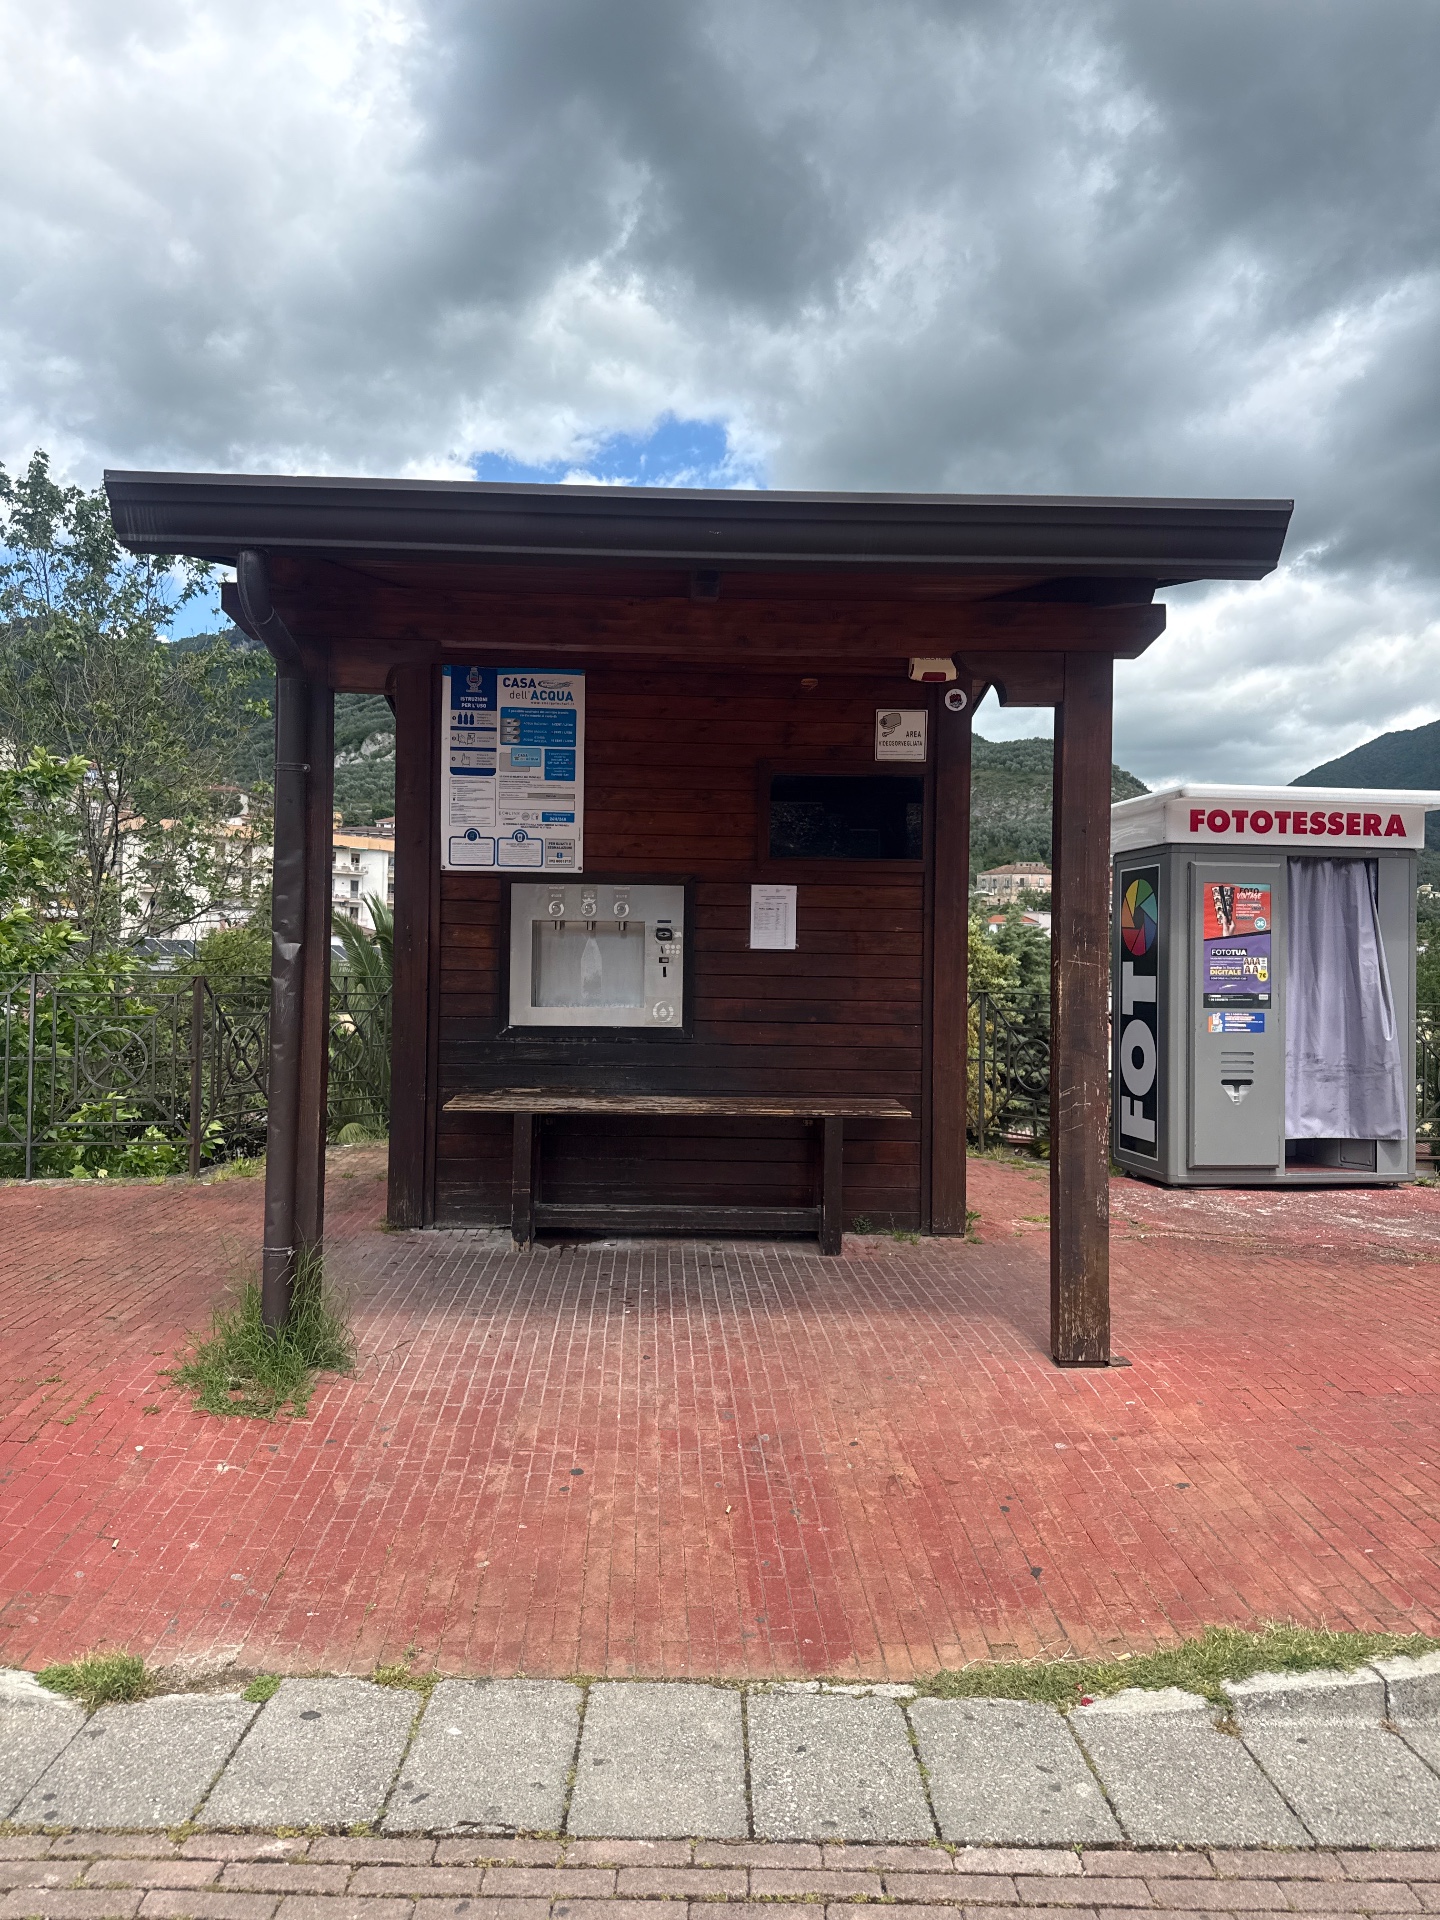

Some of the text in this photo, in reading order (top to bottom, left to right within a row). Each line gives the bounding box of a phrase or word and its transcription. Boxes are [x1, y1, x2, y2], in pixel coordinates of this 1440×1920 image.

[503, 677, 536, 688] CASA
[905, 730, 922, 738] AREA
[1189, 809, 1407, 838] FOTOTESSERA
[1236, 892, 1263, 900] VINTAGE
